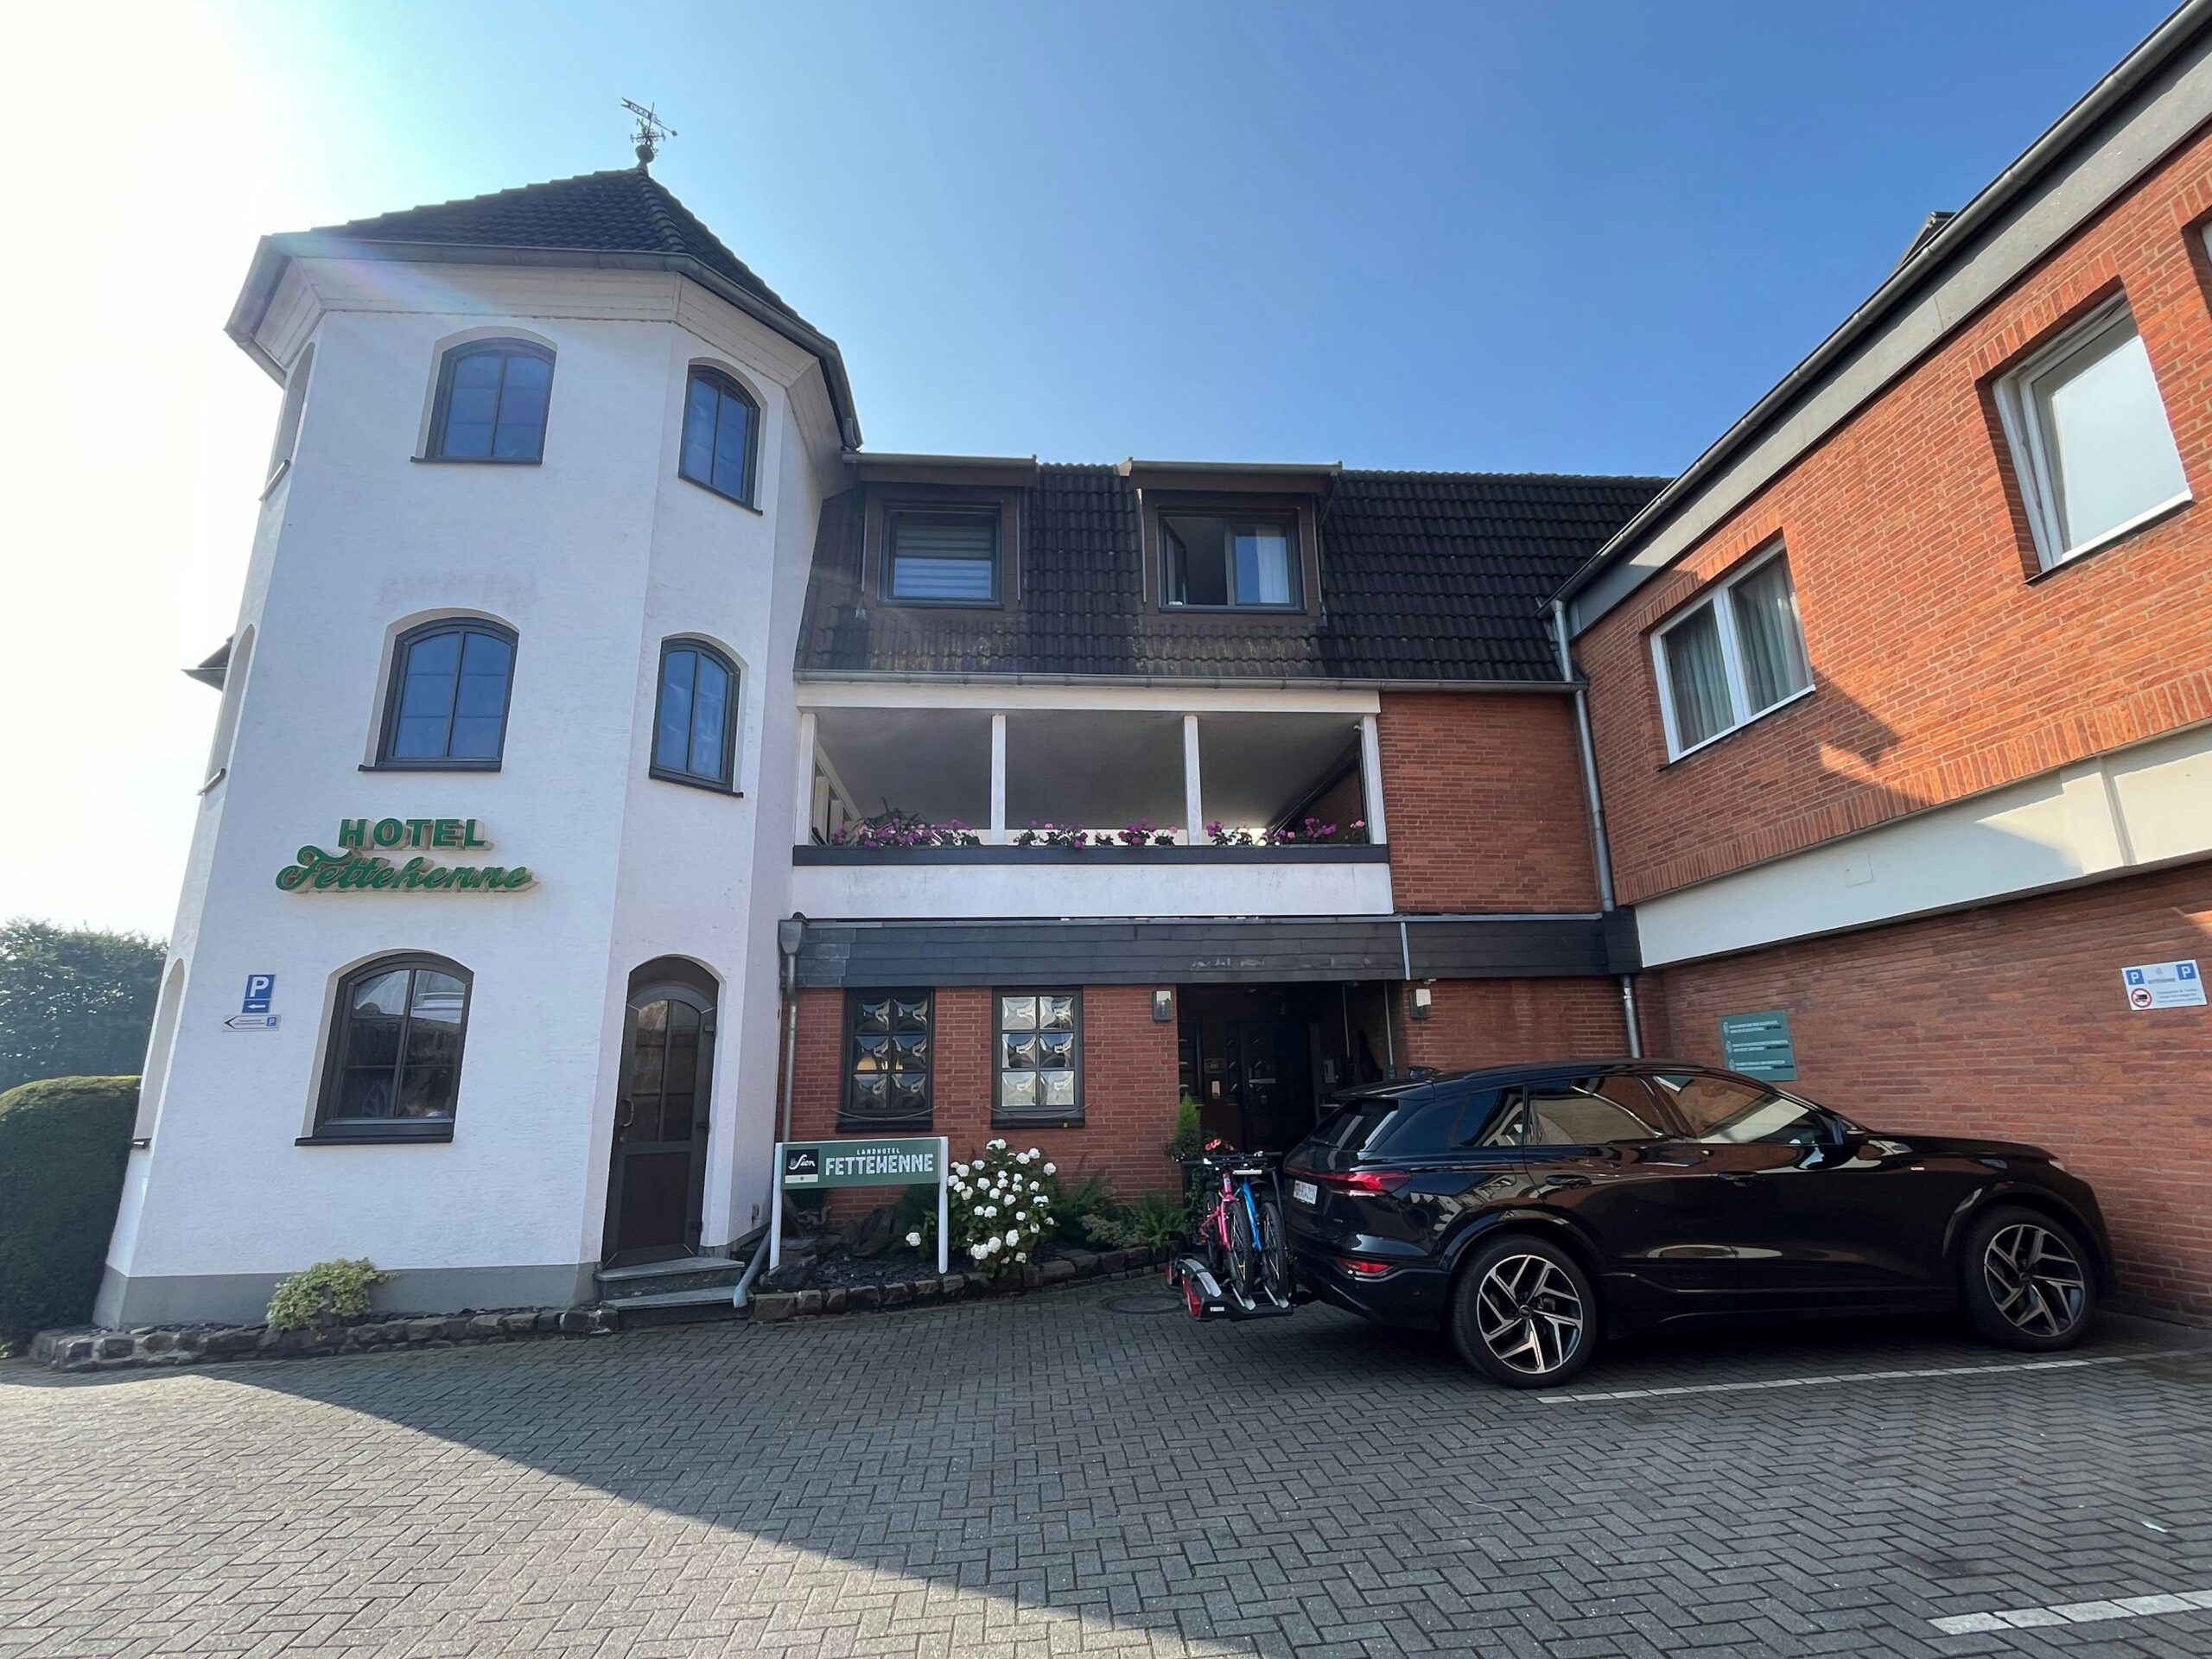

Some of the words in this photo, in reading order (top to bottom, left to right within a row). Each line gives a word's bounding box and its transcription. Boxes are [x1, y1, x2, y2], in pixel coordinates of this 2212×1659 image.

[338, 817, 488, 849] HOTEL
[276, 845, 534, 892] Fettehenne
[2130, 972, 2139, 983] P
[2181, 966, 2191, 978] P
[249, 976, 270, 997] P
[788, 1154, 816, 1170] Sion
[825, 1154, 934, 1176] FETTEHENNE
